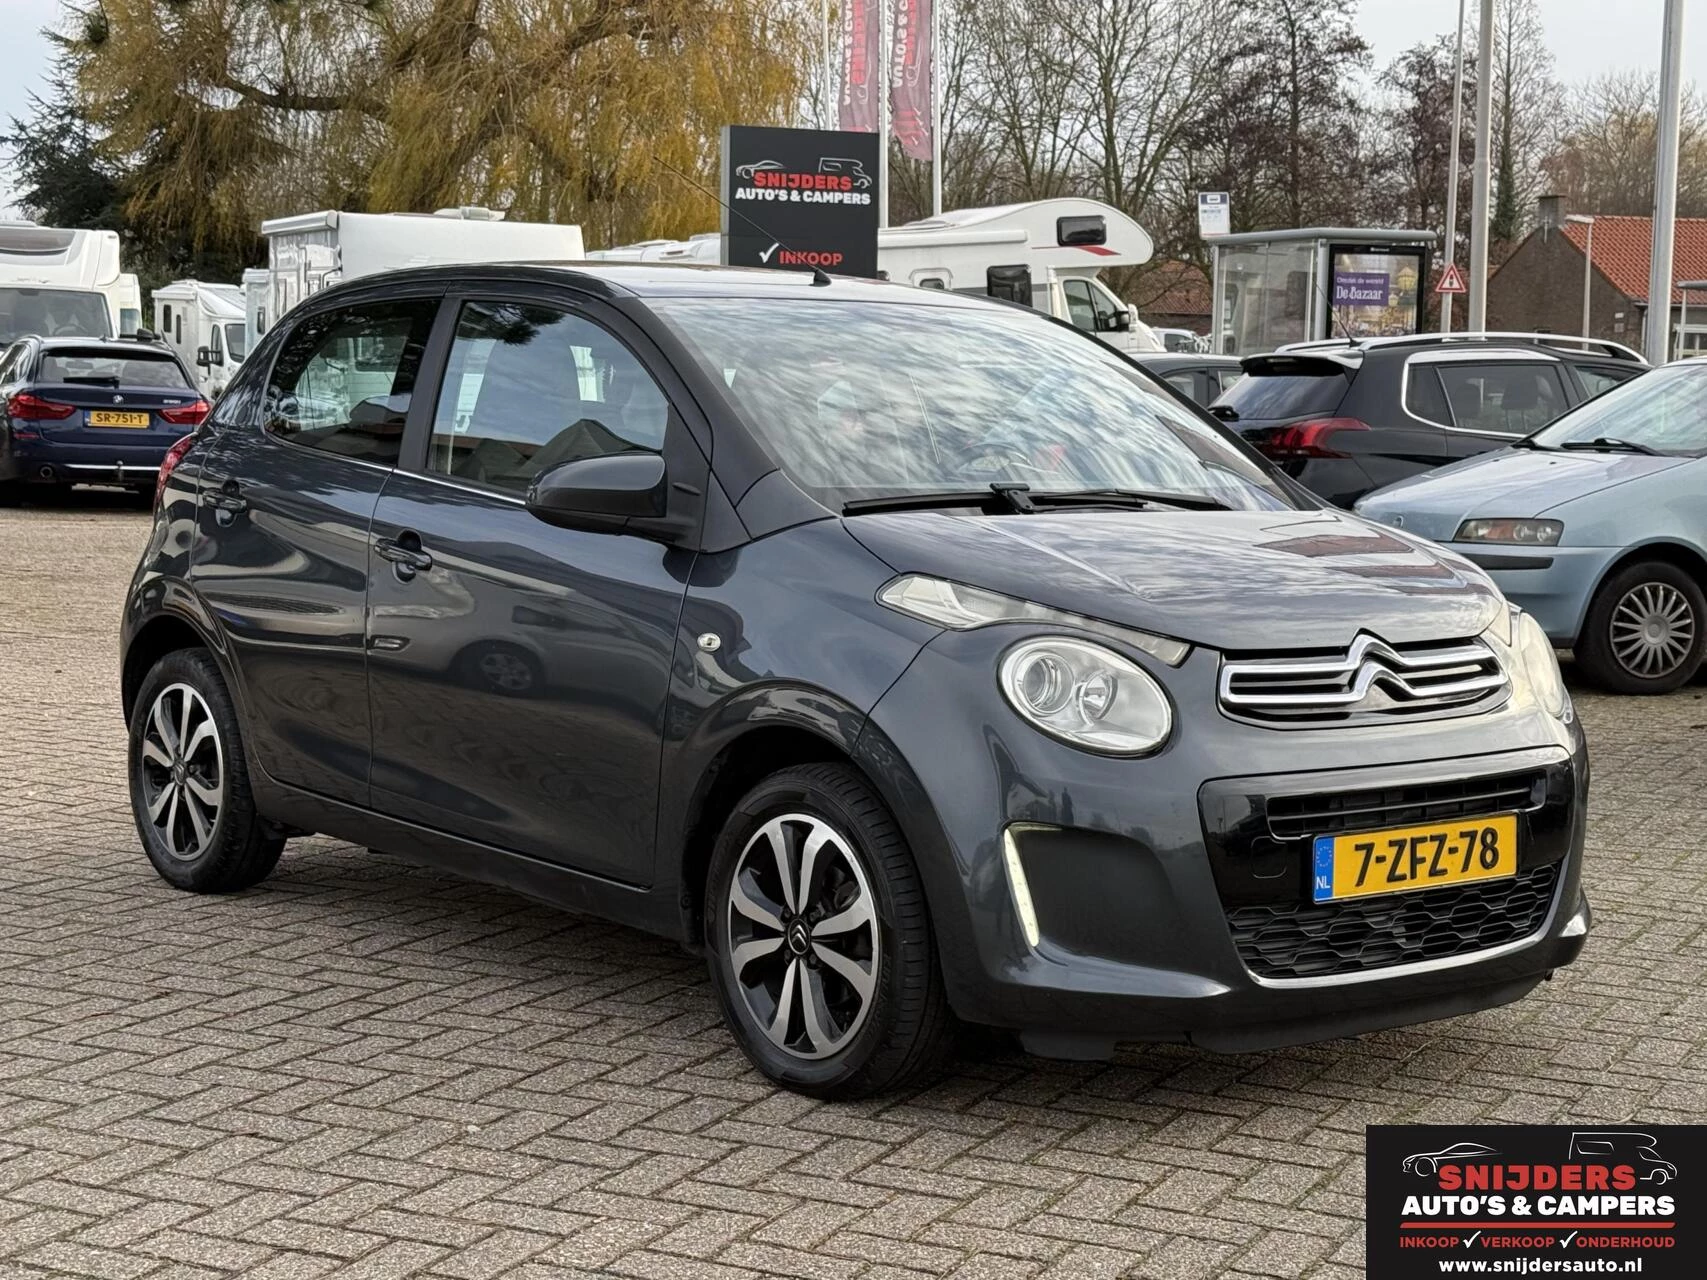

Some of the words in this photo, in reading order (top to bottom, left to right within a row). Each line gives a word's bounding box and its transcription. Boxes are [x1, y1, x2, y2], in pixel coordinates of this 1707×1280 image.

[754, 172, 852, 191] SNIJDERS
[735, 187, 788, 202] AUTO'S
[790, 190, 801, 202] &
[803, 191, 871, 205] CAMPERS
[779, 251, 843, 265] INKOOP
[96, 412, 144, 424] SR-751-T
[1316, 876, 1330, 889] NL
[1354, 827, 1499, 887] 7-ZFZ-78
